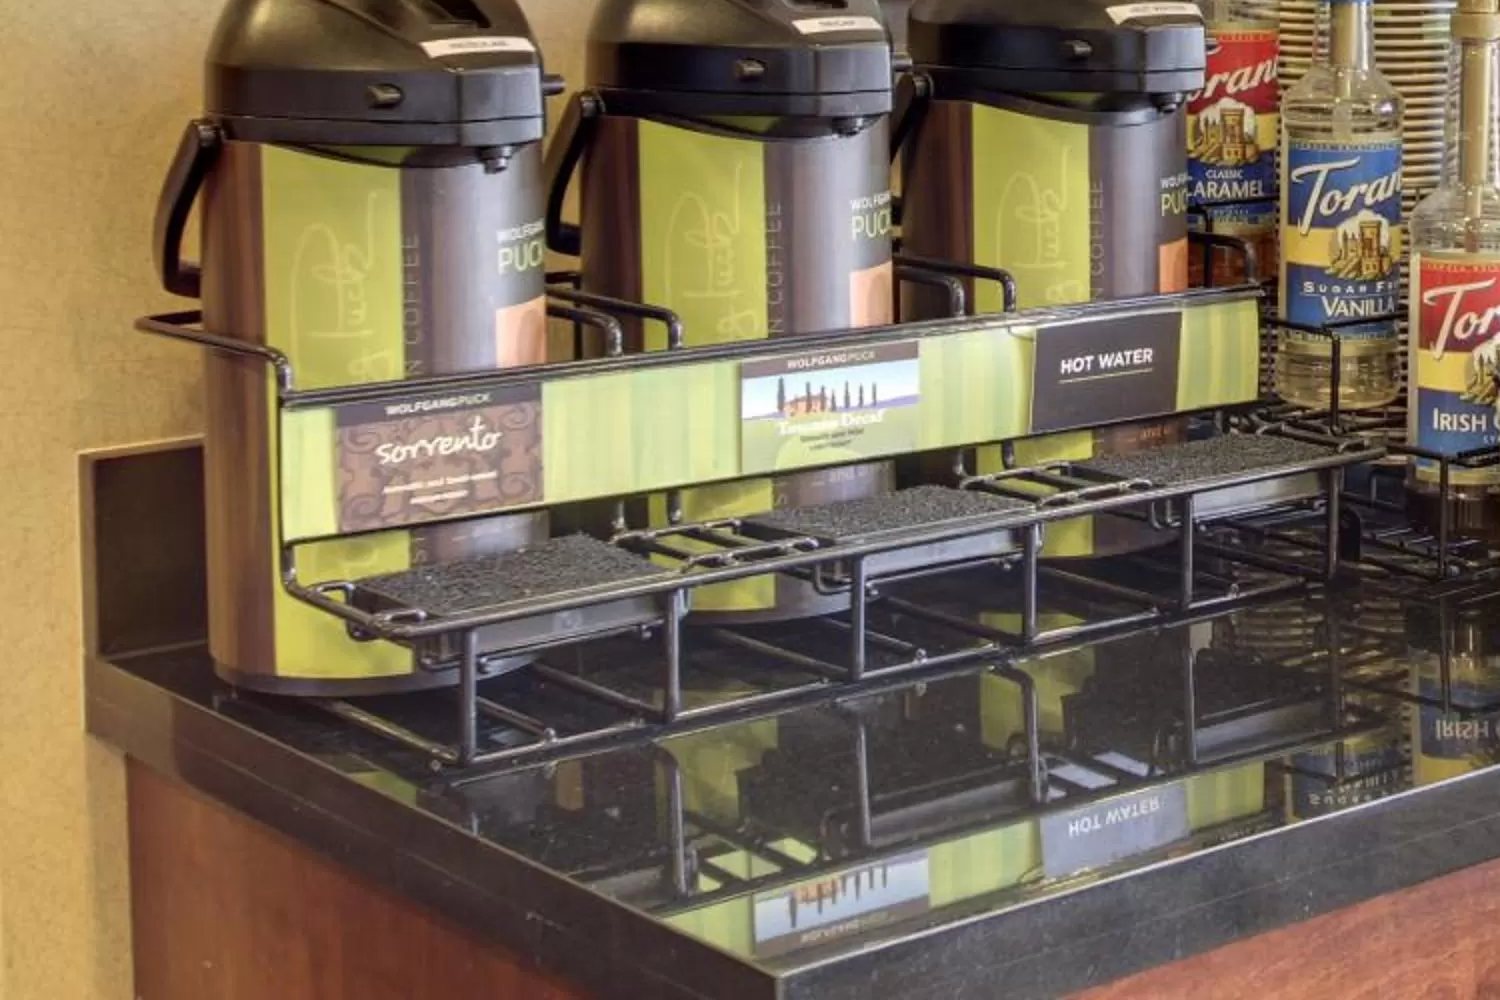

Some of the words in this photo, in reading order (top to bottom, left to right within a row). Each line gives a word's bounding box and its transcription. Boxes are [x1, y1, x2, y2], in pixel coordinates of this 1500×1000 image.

[1190, 180, 1264, 201] ARAMEL
[1291, 156, 1402, 236] Toran
[1303, 281, 1367, 293] SUGAR
[1321, 296, 1395, 318] VANILLA
[1060, 355, 1094, 375] HOT
[1098, 347, 1153, 369] WATER
[1433, 407, 1487, 433] IRISH
